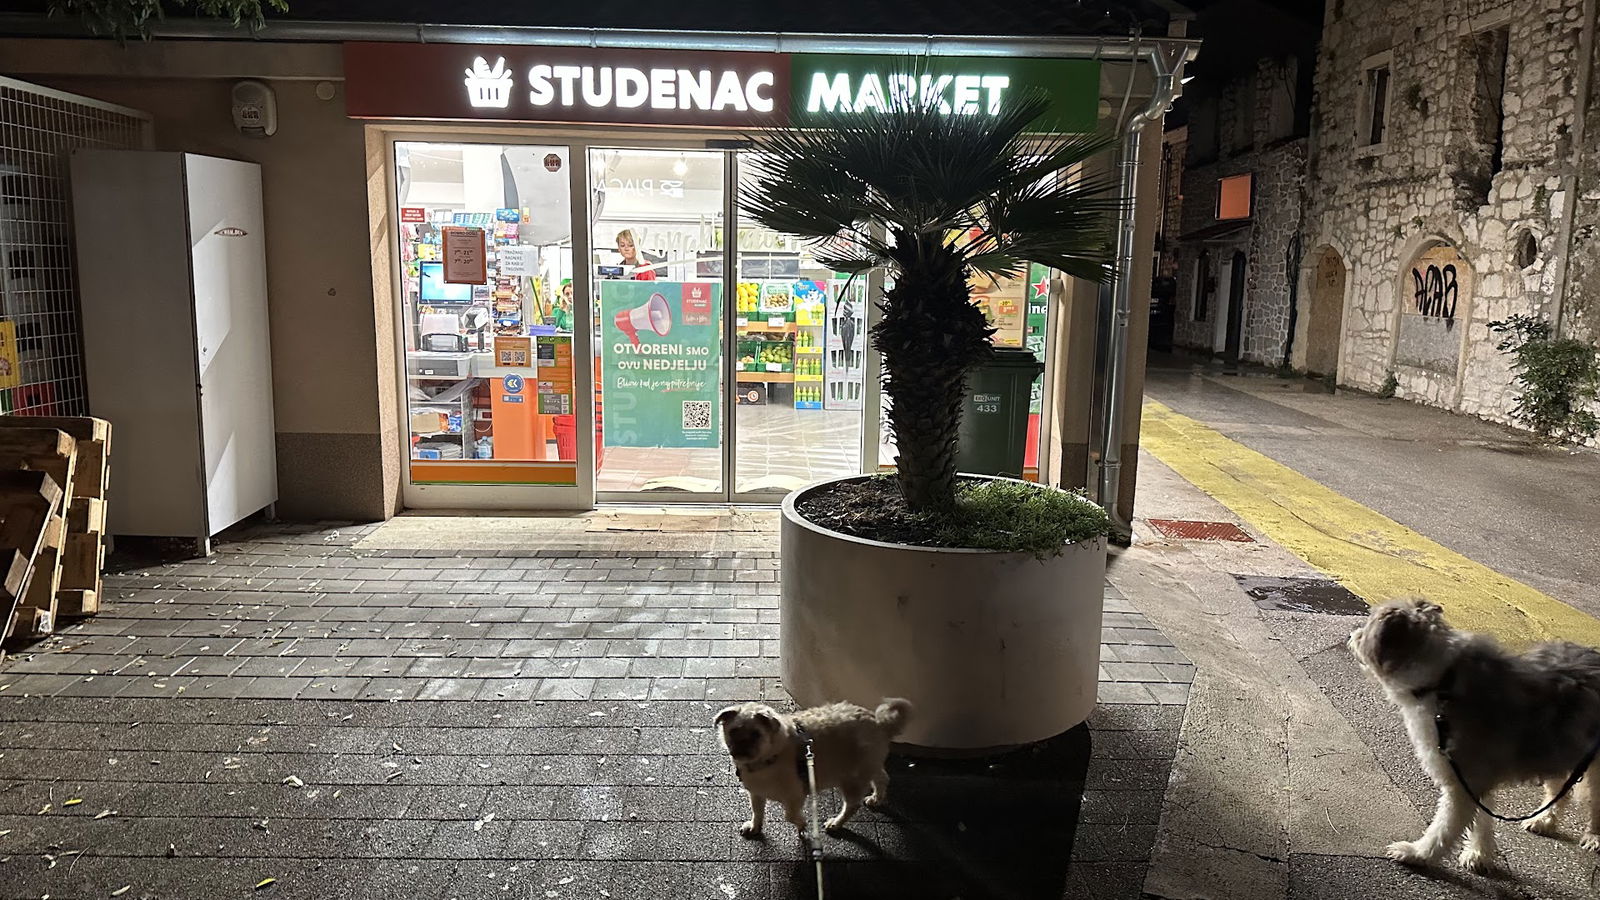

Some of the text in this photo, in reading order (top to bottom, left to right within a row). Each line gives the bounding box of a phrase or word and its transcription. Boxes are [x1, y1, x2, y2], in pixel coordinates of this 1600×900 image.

[528, 65, 1009, 115] STUDENAC MARKET
[1412, 264, 1458, 318] ACAB
[613, 343, 709, 355] OTVORENI SMO
[618, 359, 707, 371] OVU NEDJELJU
[976, 404, 997, 413] 433
